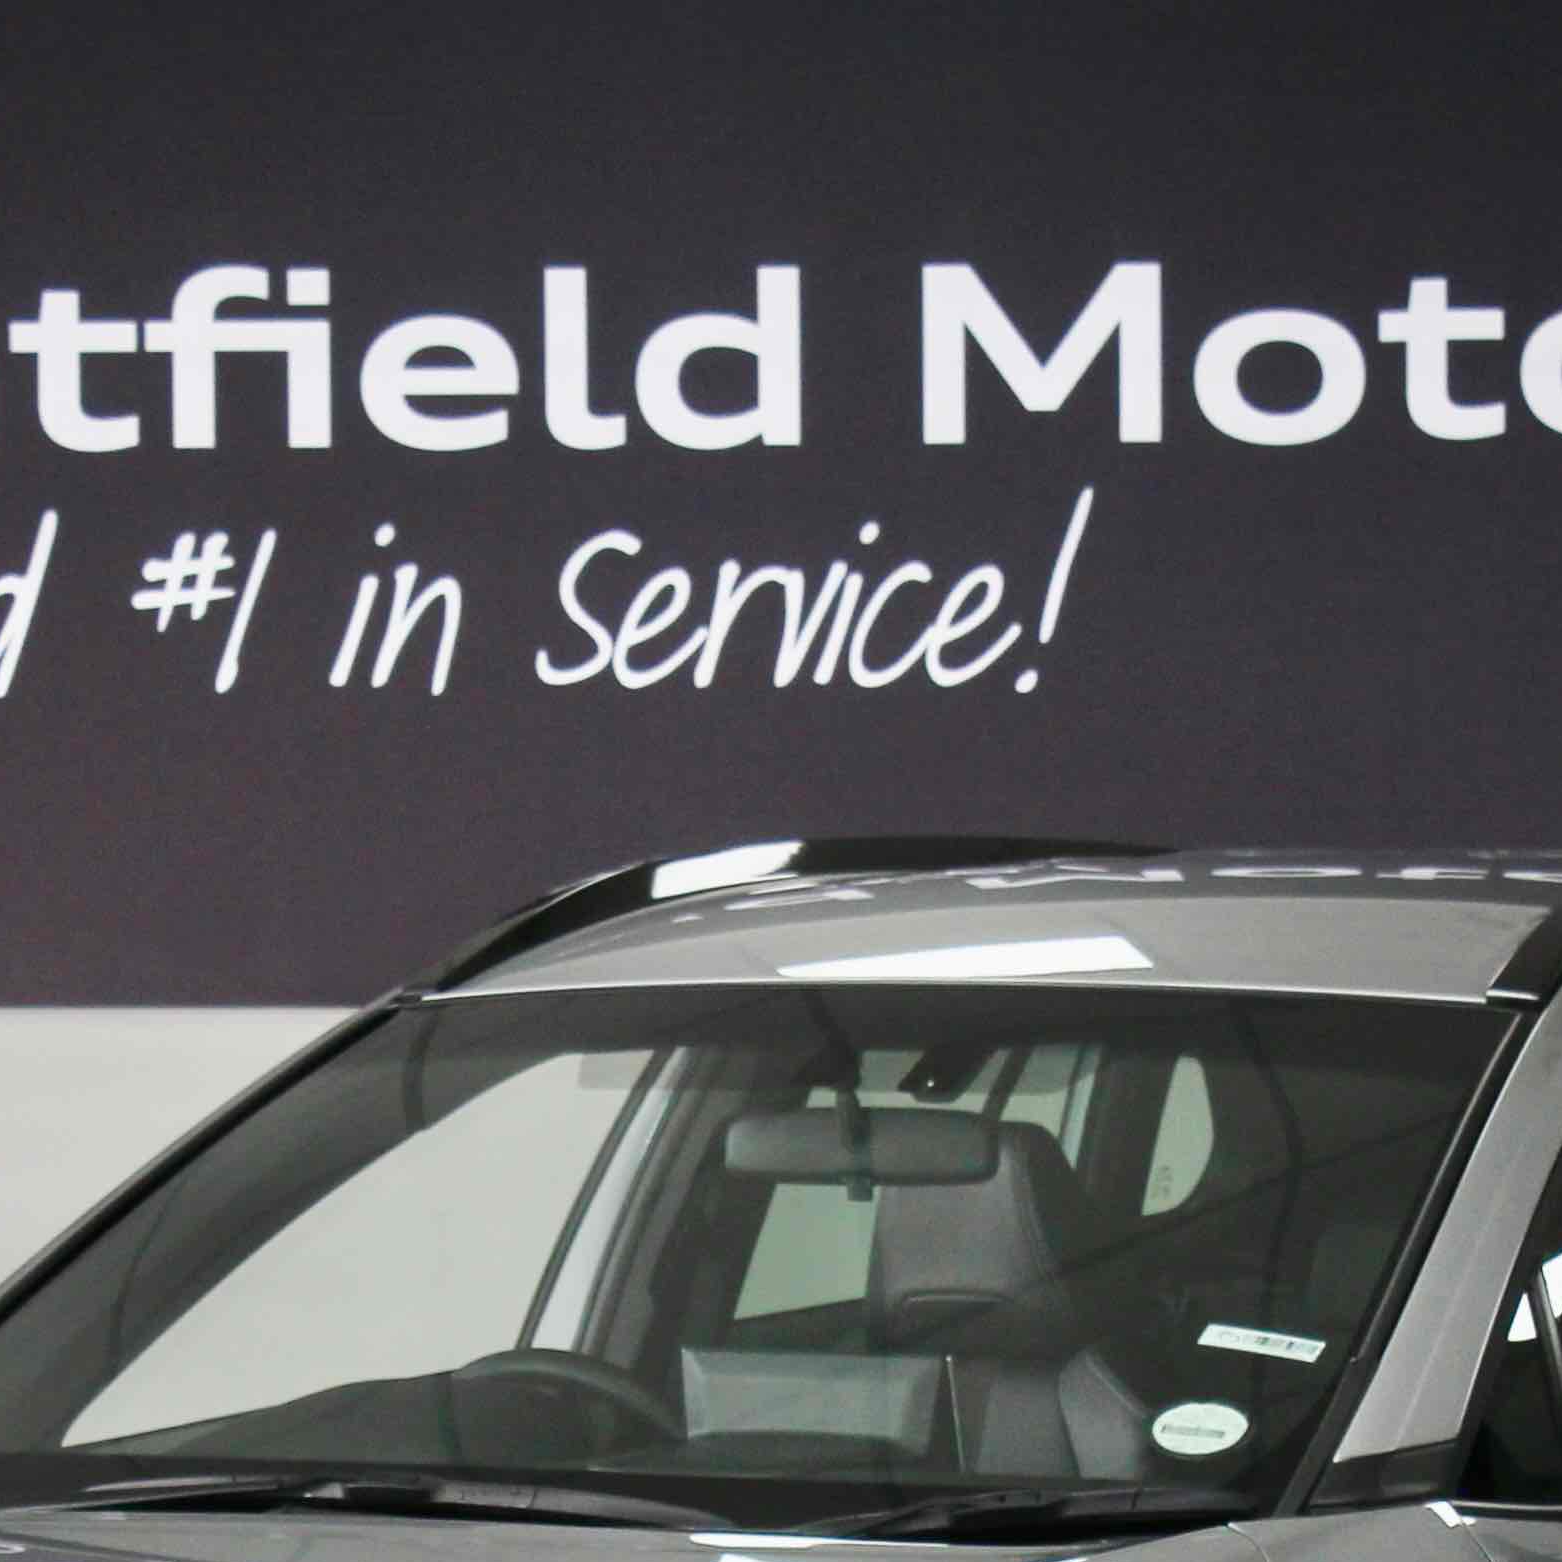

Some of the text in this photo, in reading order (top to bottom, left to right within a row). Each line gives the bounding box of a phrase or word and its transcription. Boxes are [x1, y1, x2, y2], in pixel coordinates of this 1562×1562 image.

[130, 528, 278, 695] #1
[328, 522, 463, 698] in
[534, 486, 1095, 695] Service!
